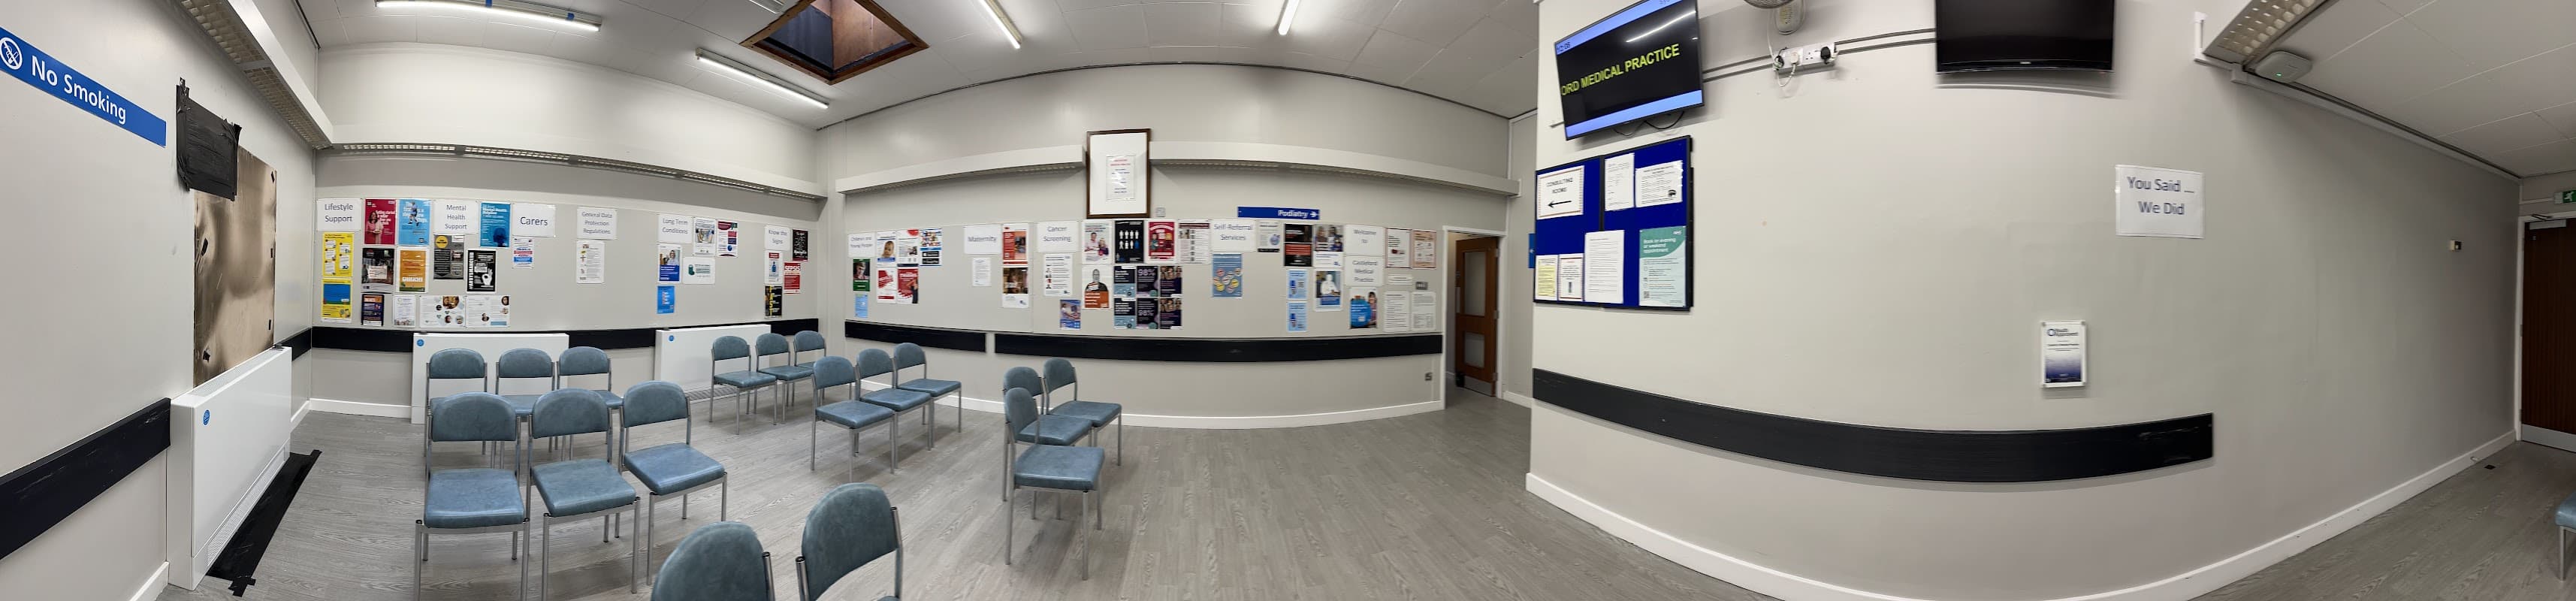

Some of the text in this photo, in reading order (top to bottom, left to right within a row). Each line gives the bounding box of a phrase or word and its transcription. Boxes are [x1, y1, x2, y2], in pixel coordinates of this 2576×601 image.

[1580, 65, 1624, 89] MEDICAL
[1624, 44, 1681, 72] PRACTICE
[32, 55, 126, 125] No Smoking
[2127, 176, 2152, 190] You
[2154, 179, 2182, 192] Said
[325, 203, 354, 212] Lifestyle
[2138, 201, 2185, 215] We Did
[325, 215, 352, 223] Support
[1278, 210, 1309, 219] Podiatry
[520, 216, 548, 226] Carers
